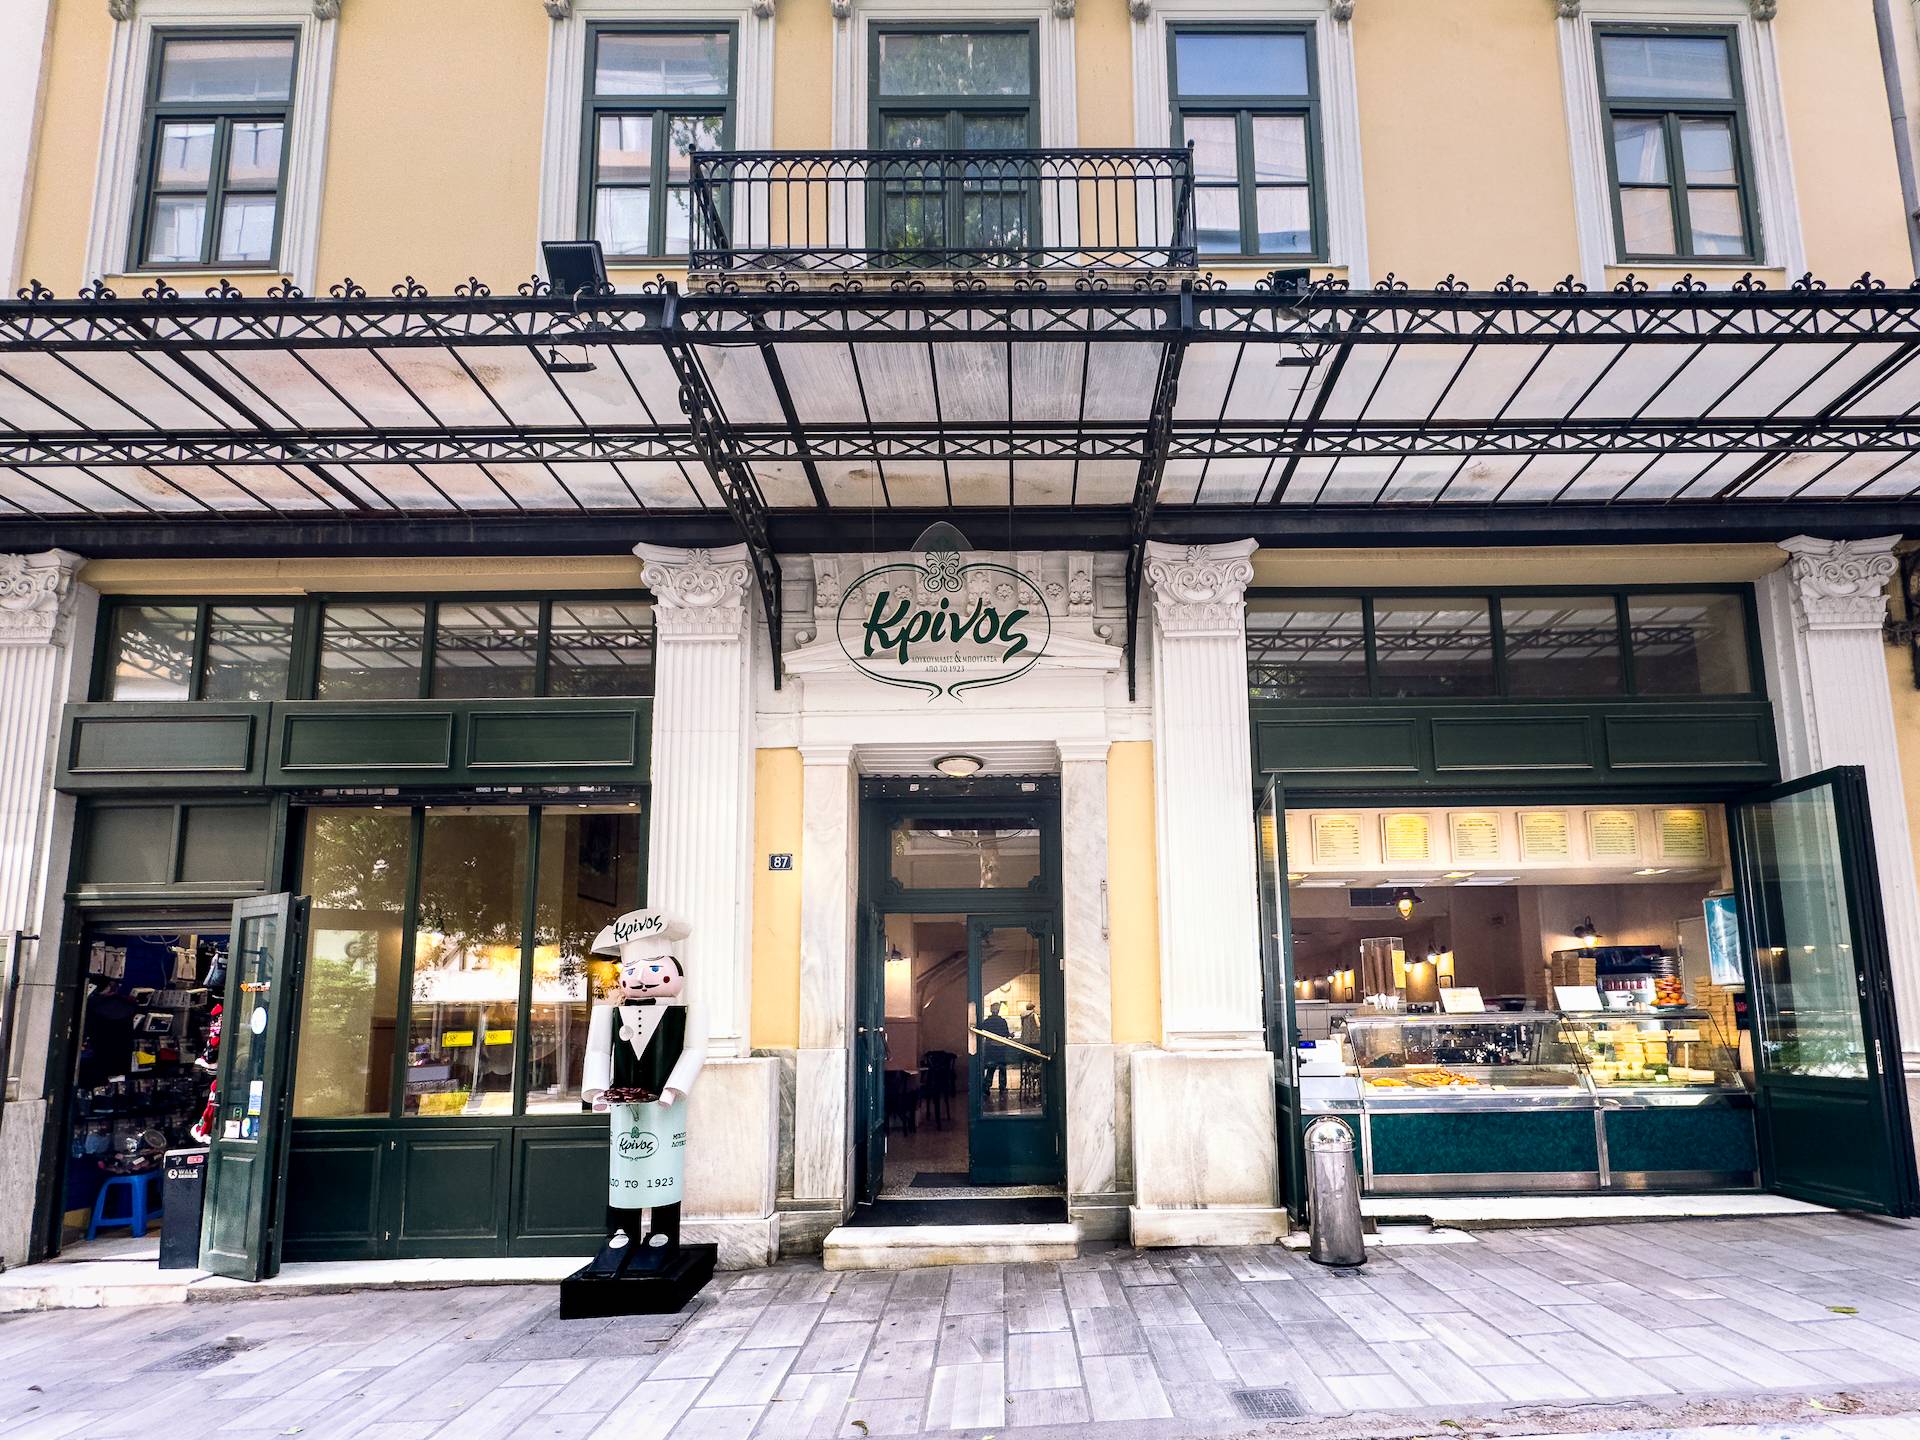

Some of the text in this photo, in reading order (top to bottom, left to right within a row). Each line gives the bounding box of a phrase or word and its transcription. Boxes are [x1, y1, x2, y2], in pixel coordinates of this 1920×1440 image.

[954, 650, 962, 663] &
[949, 665, 965, 673] 1923
[773, 856, 789, 868] 87
[646, 1176, 675, 1188] 1923
